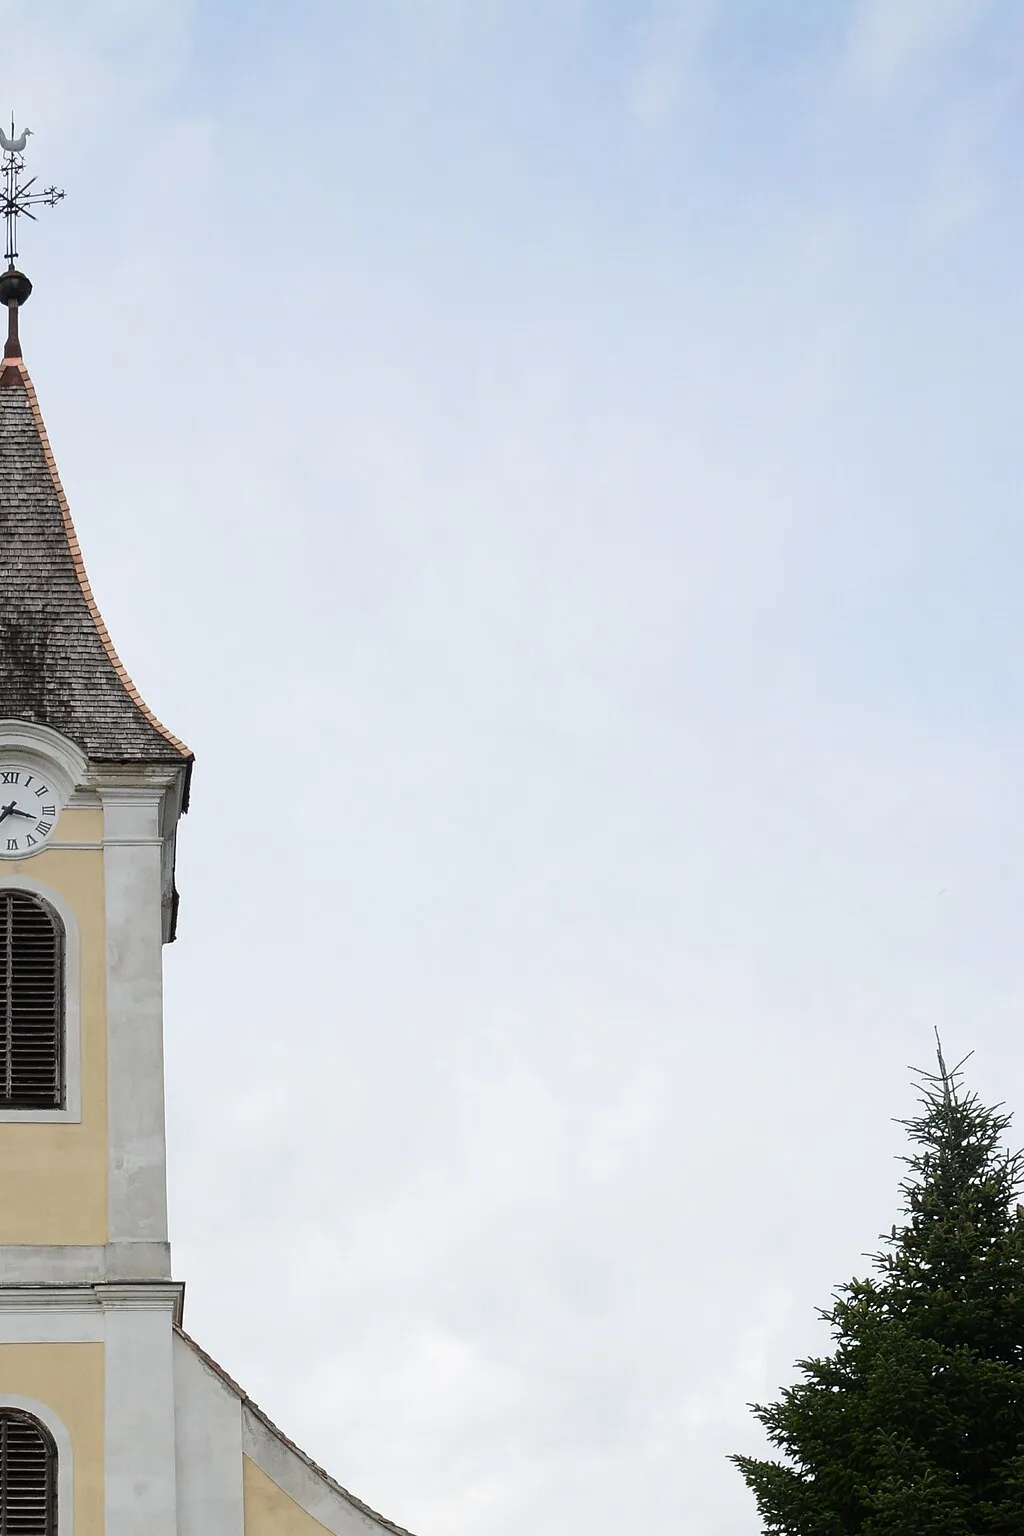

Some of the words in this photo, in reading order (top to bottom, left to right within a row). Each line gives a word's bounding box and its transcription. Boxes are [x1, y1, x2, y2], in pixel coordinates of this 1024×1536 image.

[0, 772, 20, 784] XII
[24, 776, 34, 787] I
[34, 786, 49, 797] II
[42, 805, 55, 816] III
[7, 839, 19, 850] VI
[26, 834, 38, 847] V
